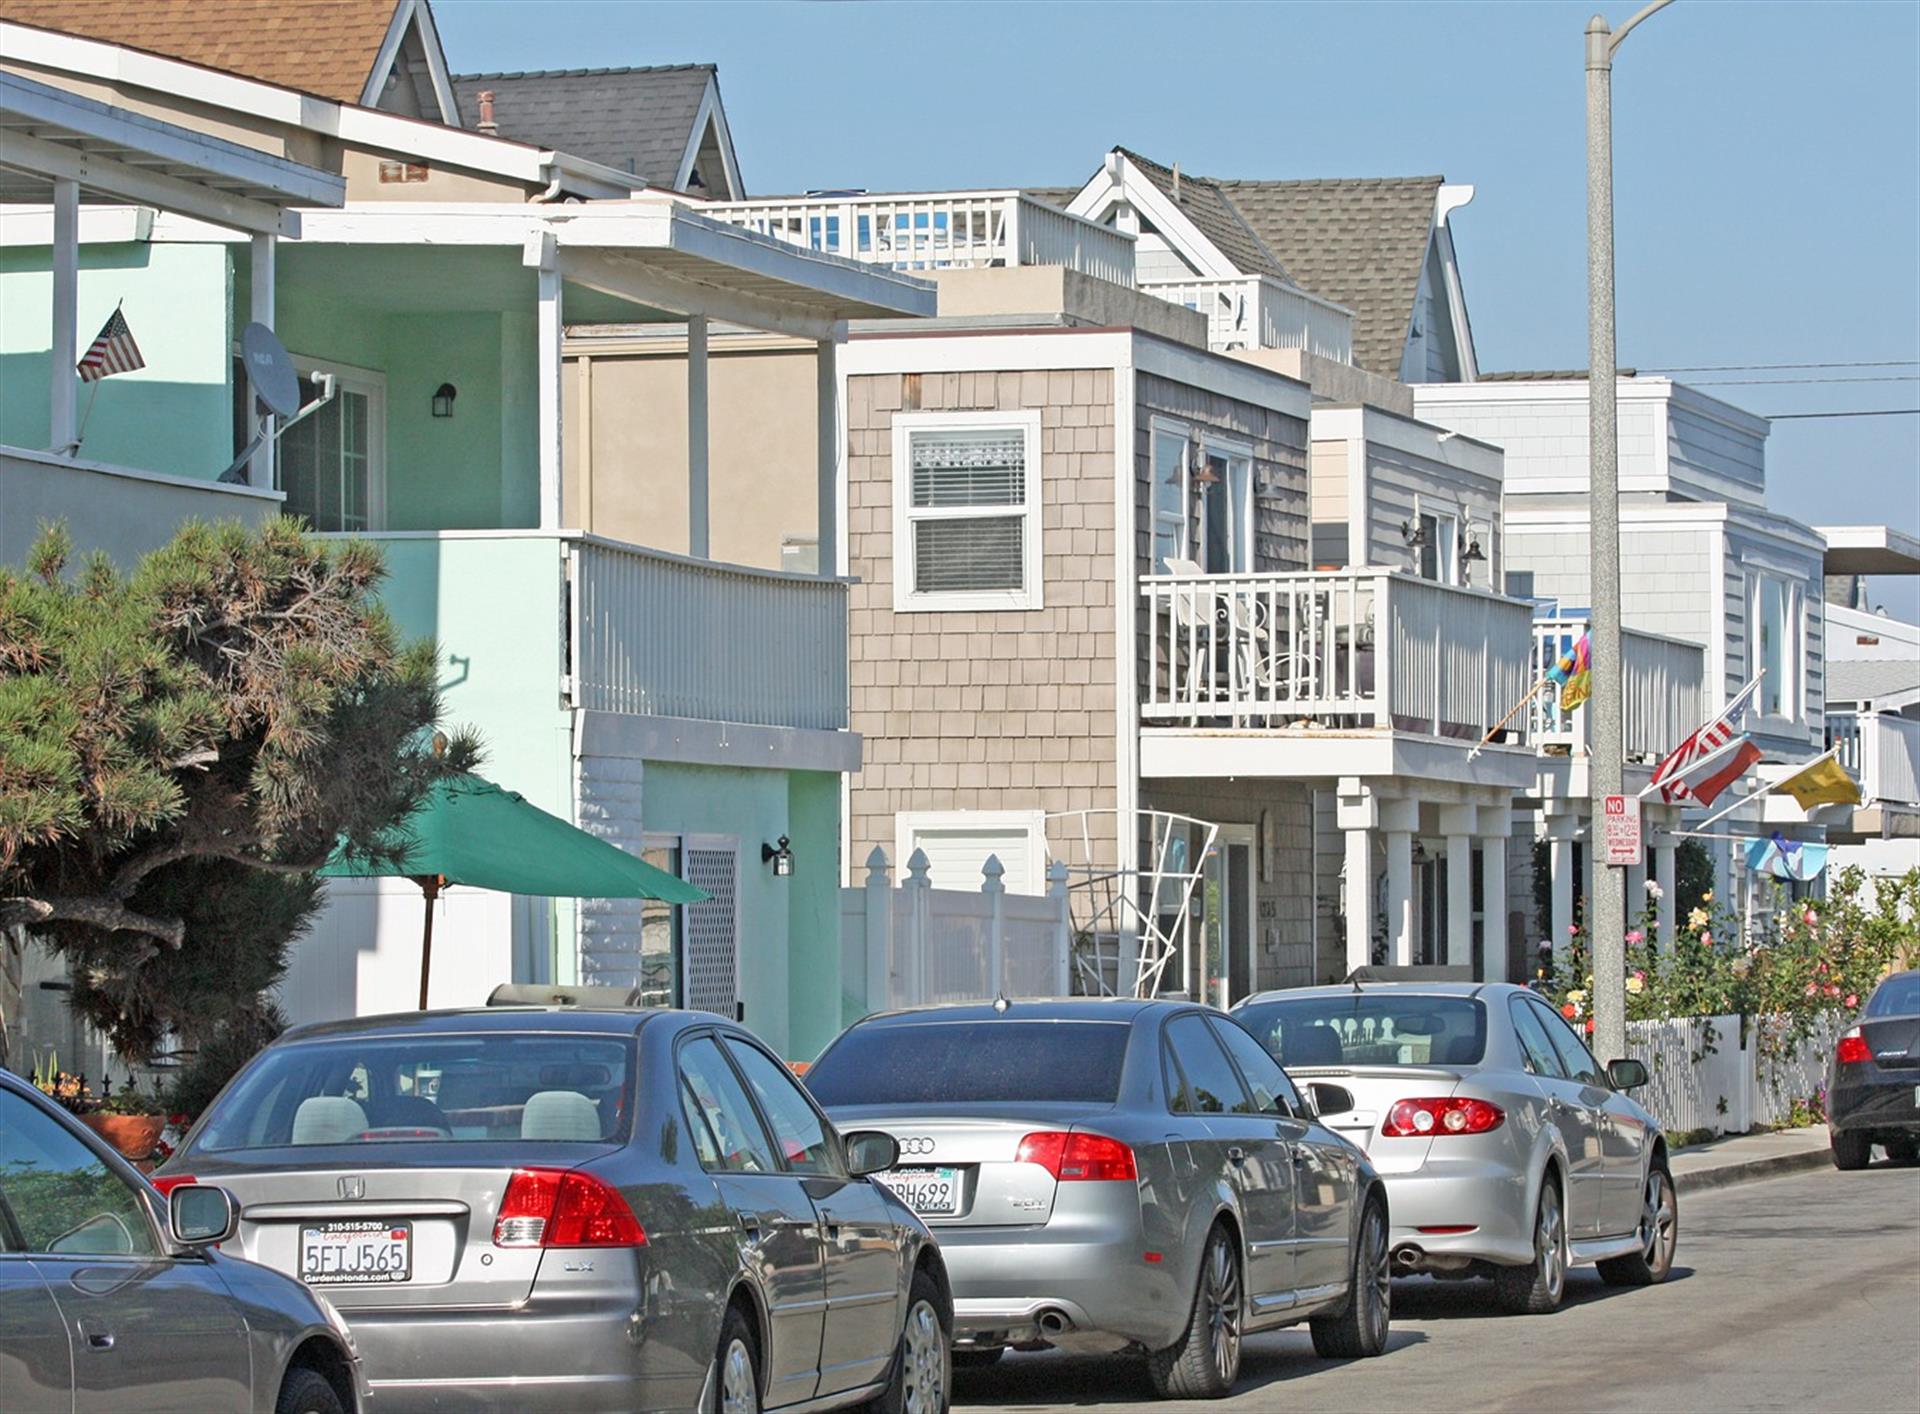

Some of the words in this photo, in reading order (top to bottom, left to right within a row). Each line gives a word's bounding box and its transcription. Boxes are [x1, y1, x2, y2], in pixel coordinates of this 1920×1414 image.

[1607, 800, 1623, 813] NO
[1608, 816, 1638, 824] PARKING
[328, 1222, 383, 1232] 310-515-5700
[323, 1231, 385, 1244] California
[306, 1244, 403, 1273] 5FIJ565
[564, 1260, 595, 1272] LX
[304, 1272, 390, 1283] GardenaHonda.com
